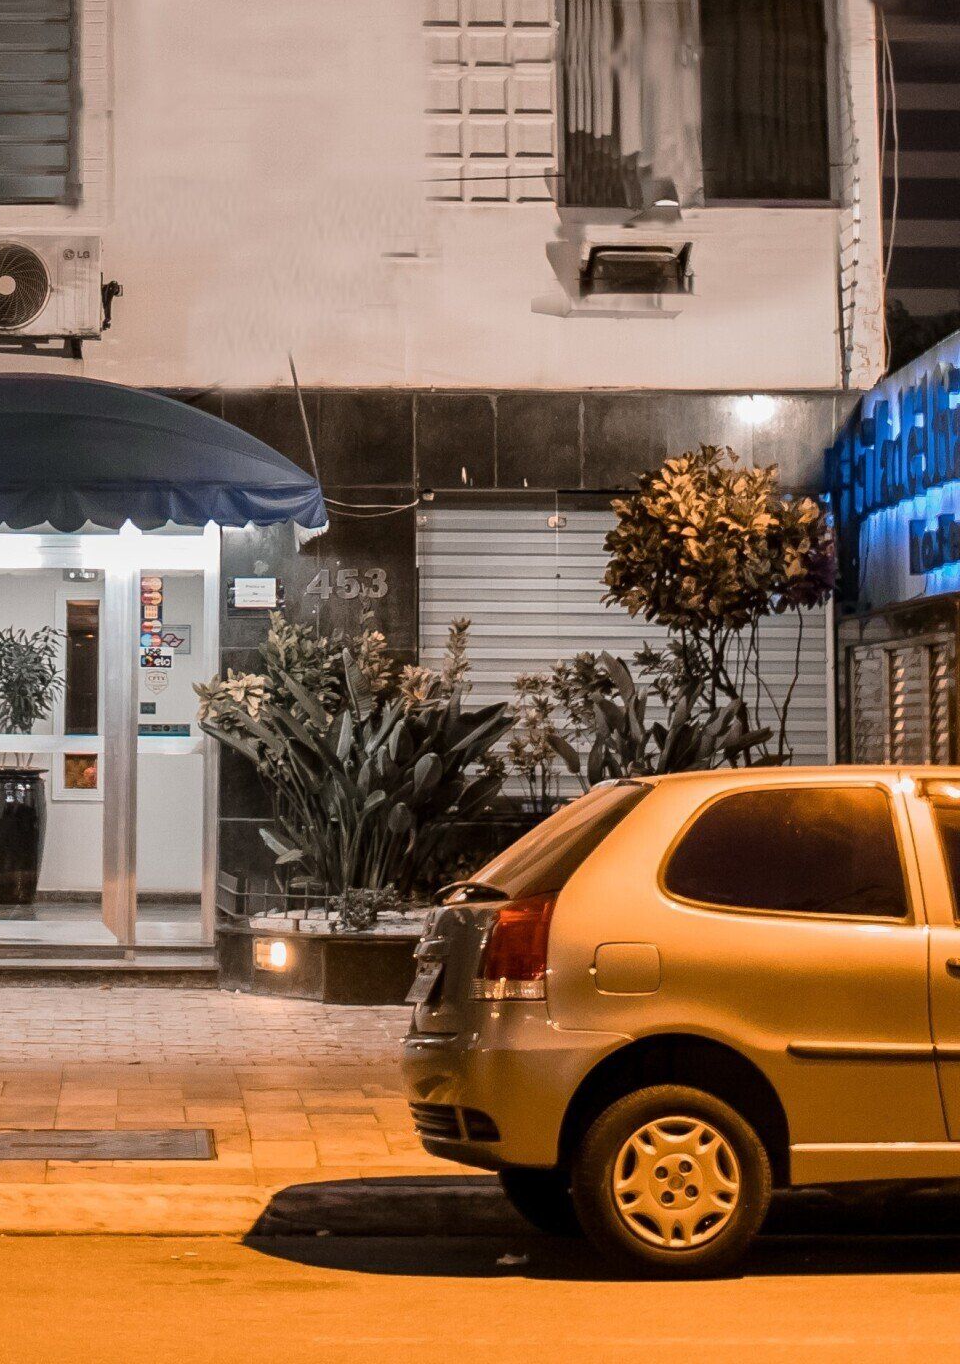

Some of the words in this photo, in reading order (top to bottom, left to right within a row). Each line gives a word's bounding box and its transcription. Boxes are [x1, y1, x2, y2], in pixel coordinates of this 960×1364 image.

[77, 250, 90, 259] LG
[307, 568, 388, 599] 453
[154, 656, 171, 666] elo
